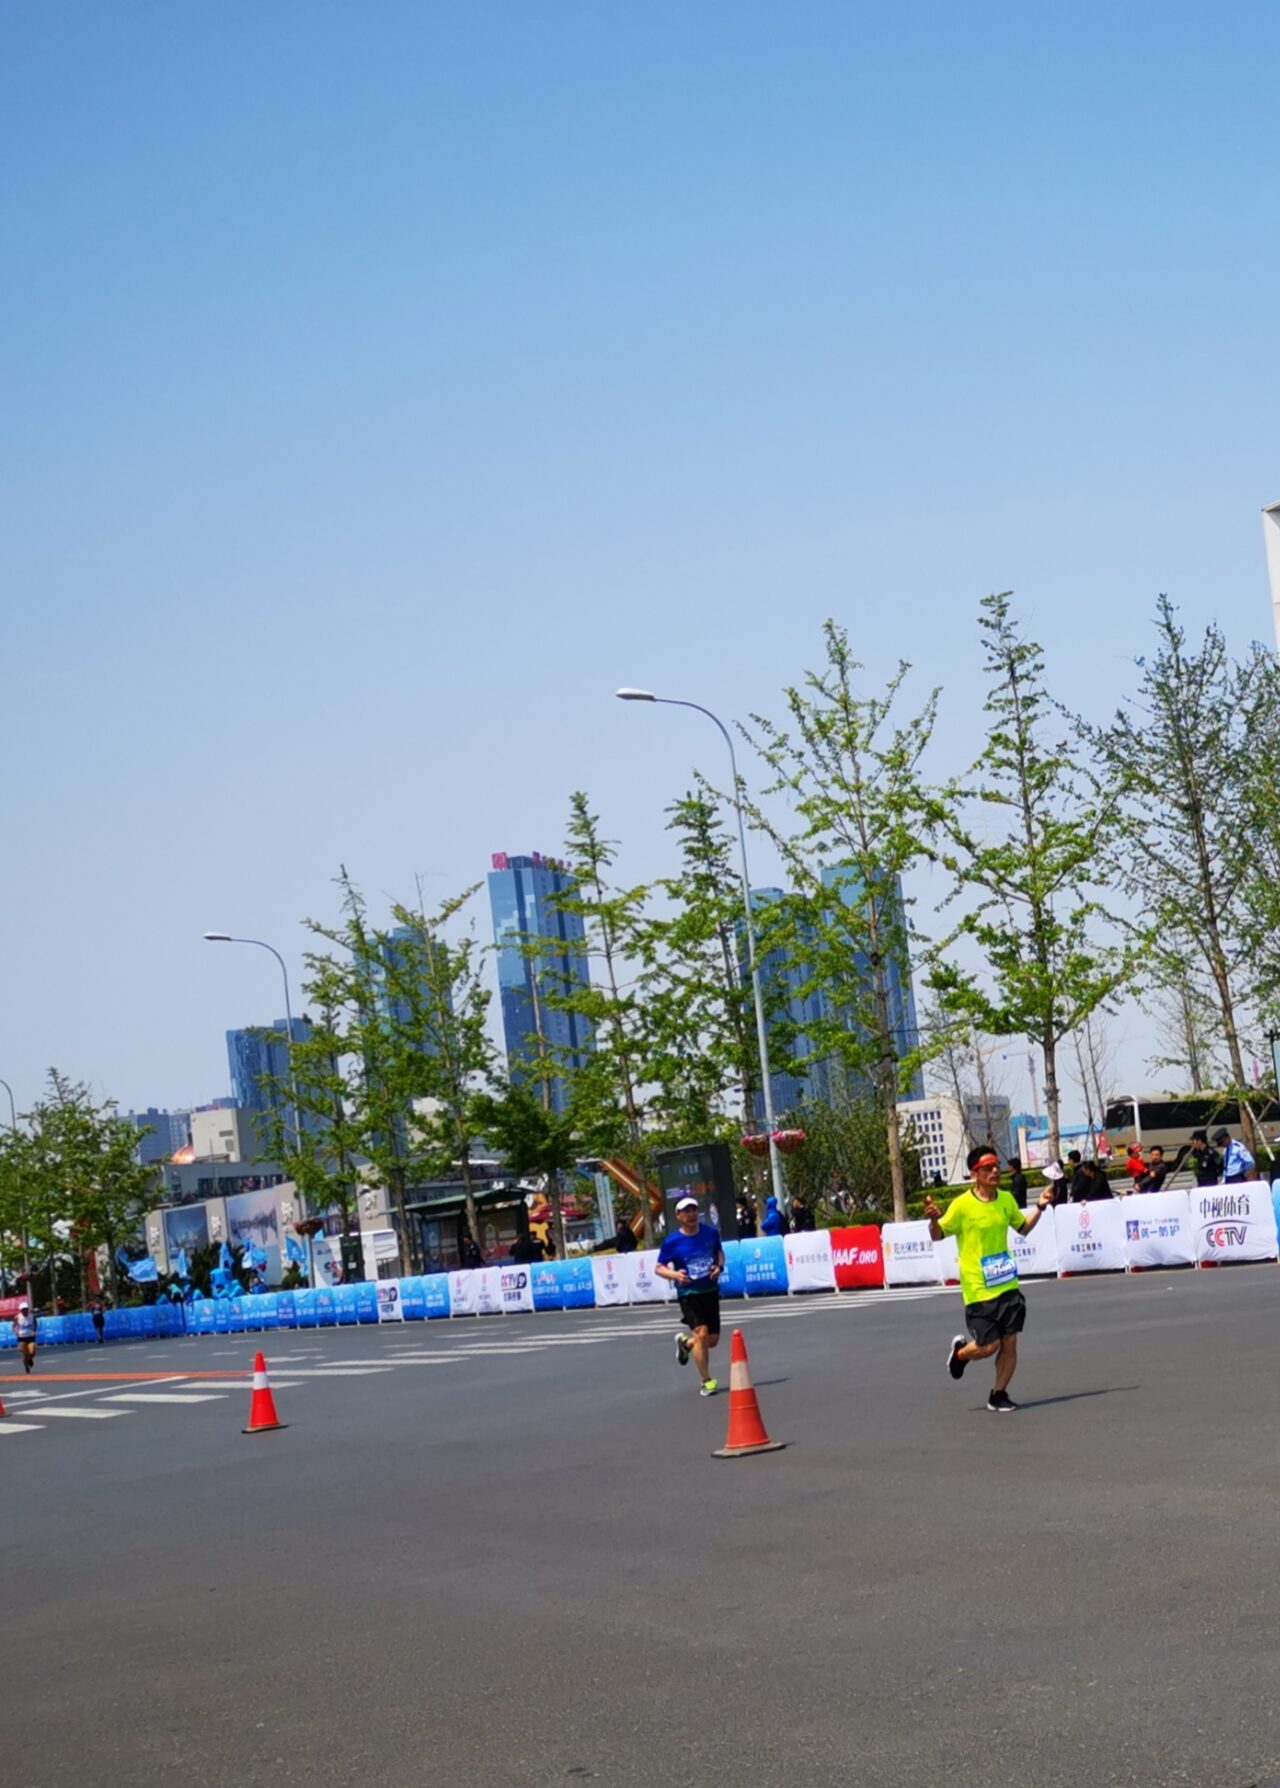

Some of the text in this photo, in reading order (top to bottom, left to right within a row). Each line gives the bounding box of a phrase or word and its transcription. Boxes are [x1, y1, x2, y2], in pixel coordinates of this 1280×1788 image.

[1199, 1193, 1250, 1219] 中视体育
[1206, 1225, 1248, 1248] CCTV
